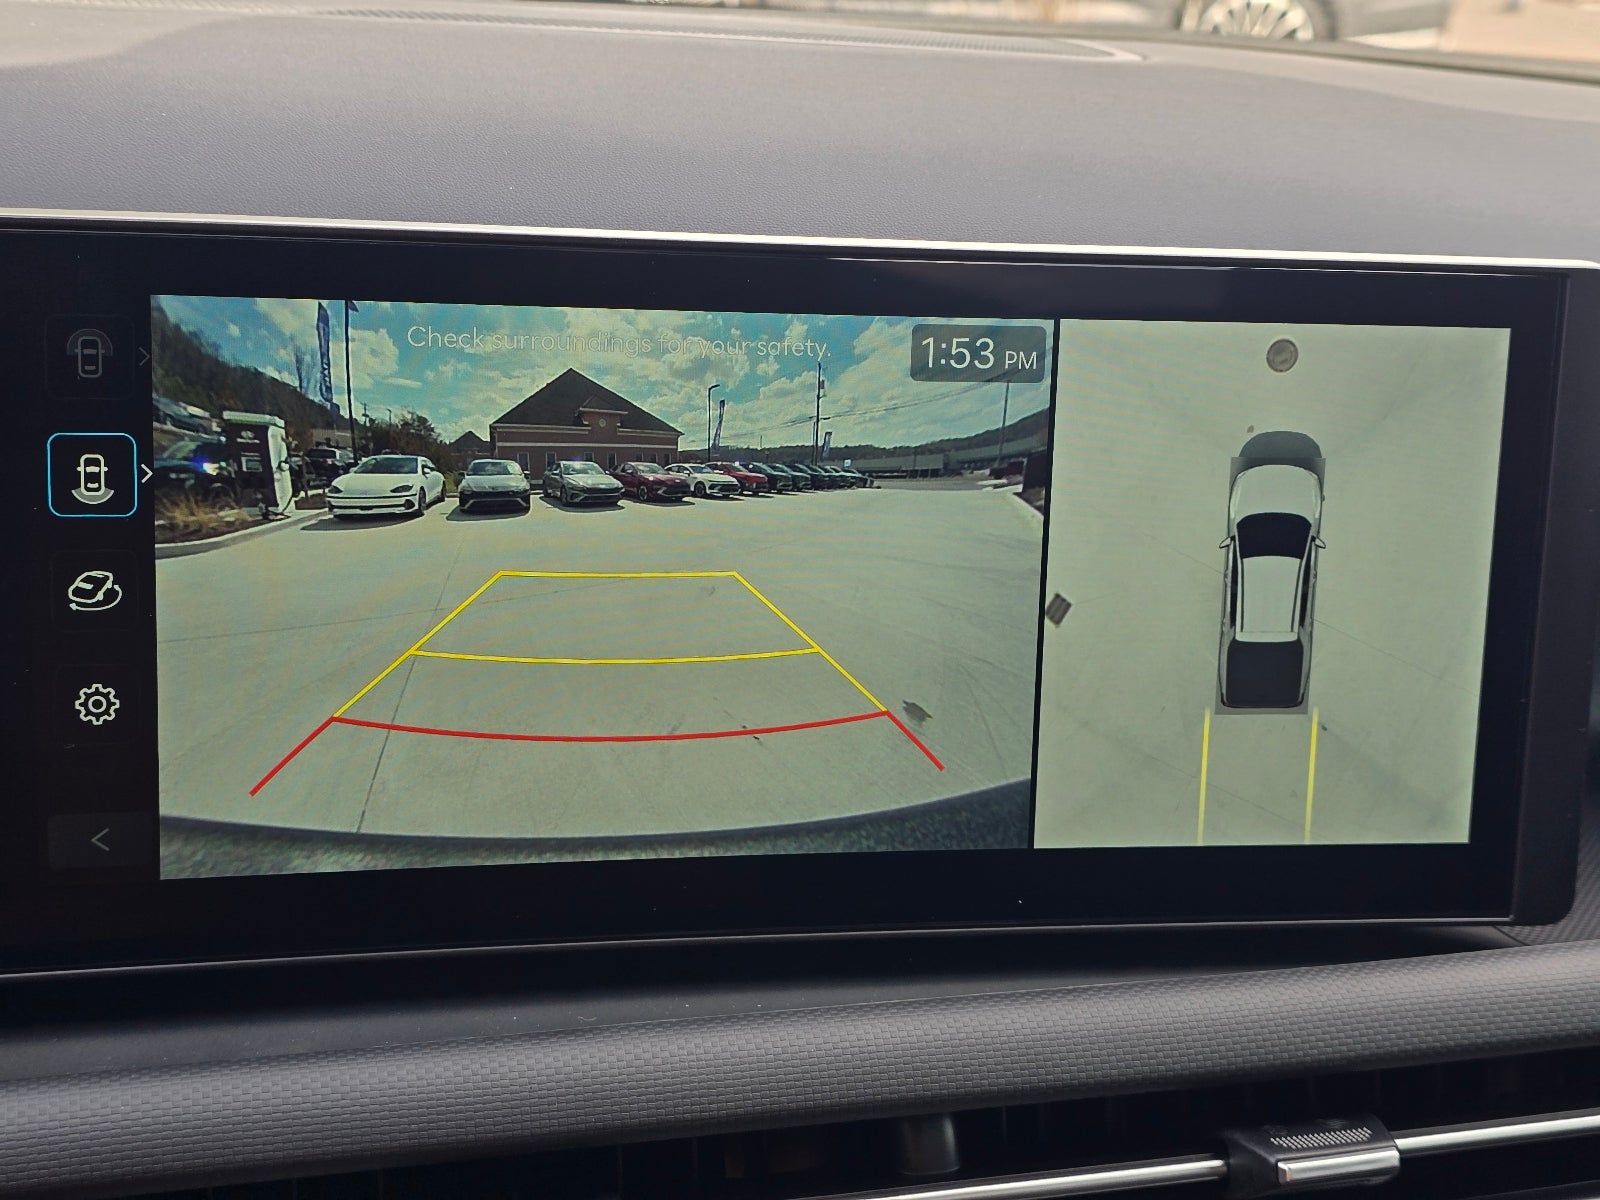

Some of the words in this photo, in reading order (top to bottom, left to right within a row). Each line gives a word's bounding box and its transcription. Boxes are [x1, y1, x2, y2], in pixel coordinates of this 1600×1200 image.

[406, 325, 485, 348] Check
[491, 331, 652, 357] surroundings
[656, 334, 696, 353] for
[699, 337, 751, 358] your
[756, 338, 832, 361] safety.
[921, 336, 995, 369] 1:53
[1004, 350, 1037, 370] PM
